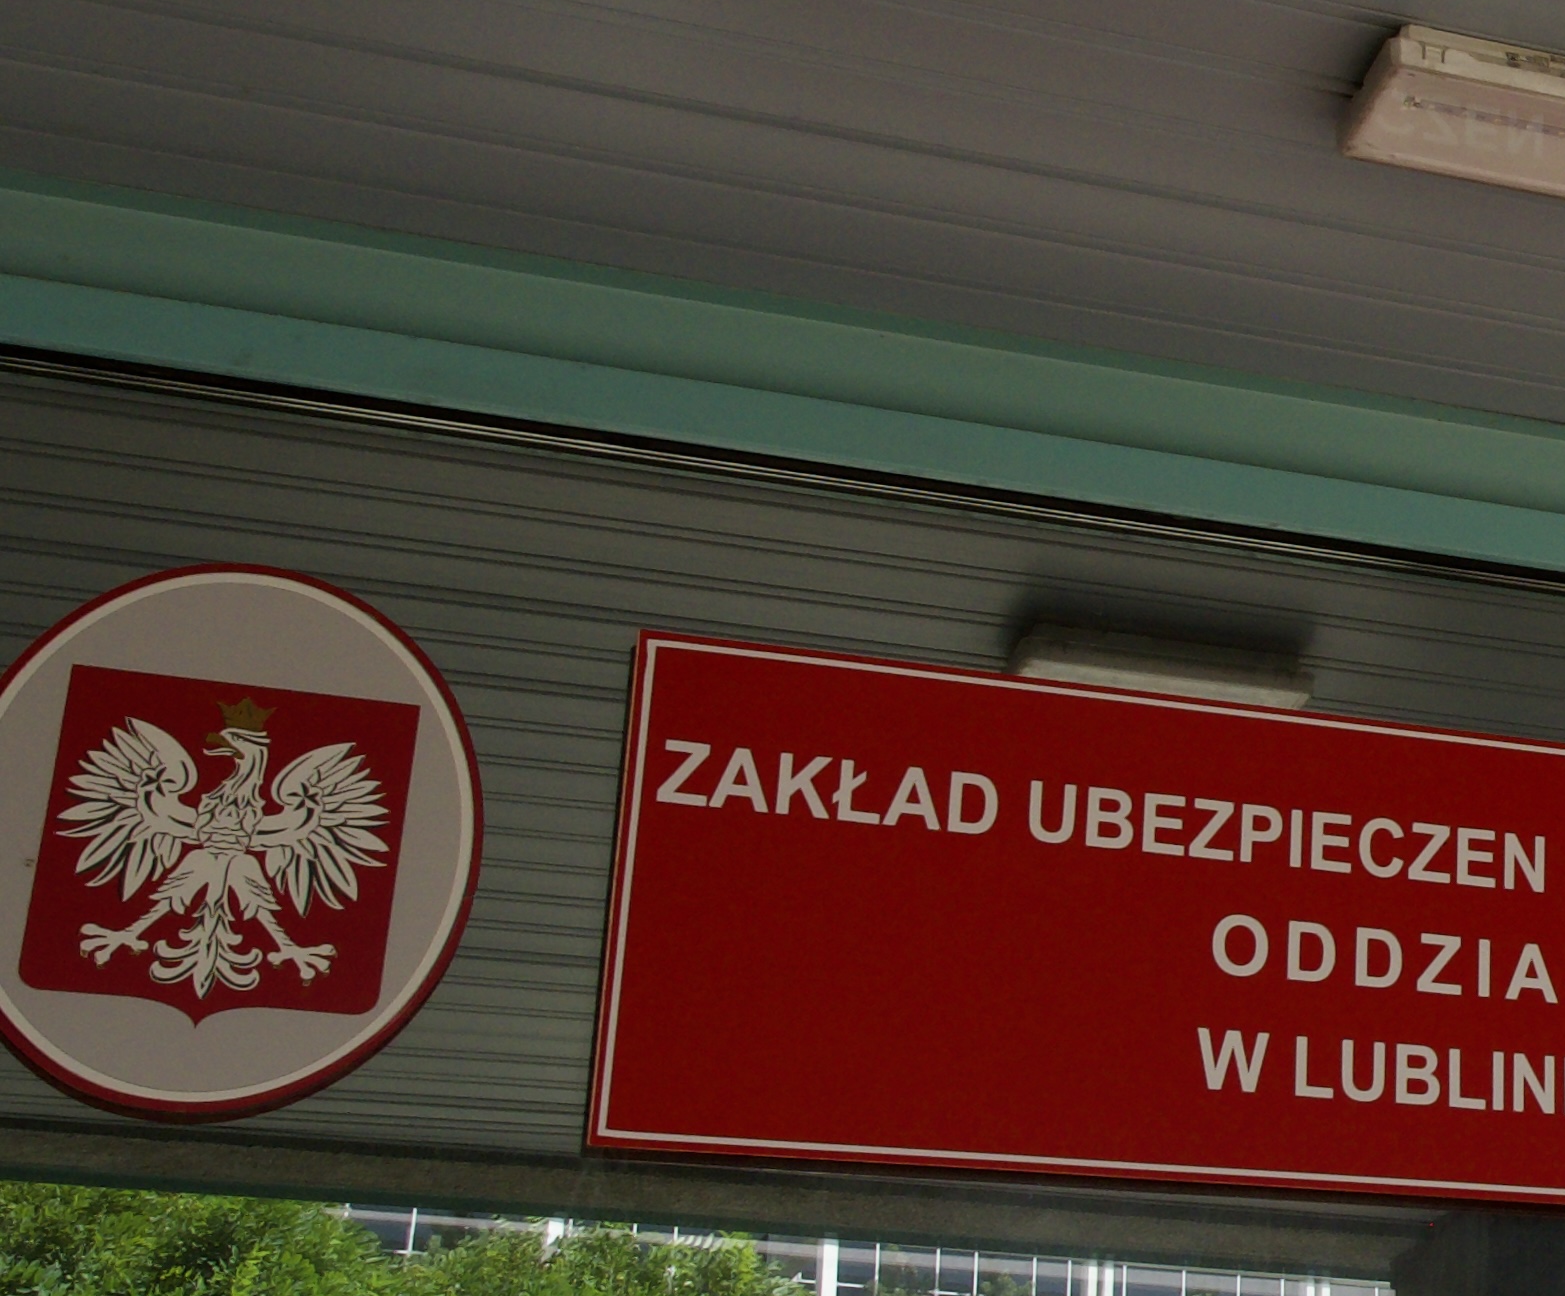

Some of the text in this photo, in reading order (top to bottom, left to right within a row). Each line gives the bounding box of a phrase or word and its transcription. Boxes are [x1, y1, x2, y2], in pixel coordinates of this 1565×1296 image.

[656, 739, 998, 834] ZAKŁAD
[1029, 780, 1545, 893] UBEZPIECZEN
[1197, 1027, 1269, 1093] W
